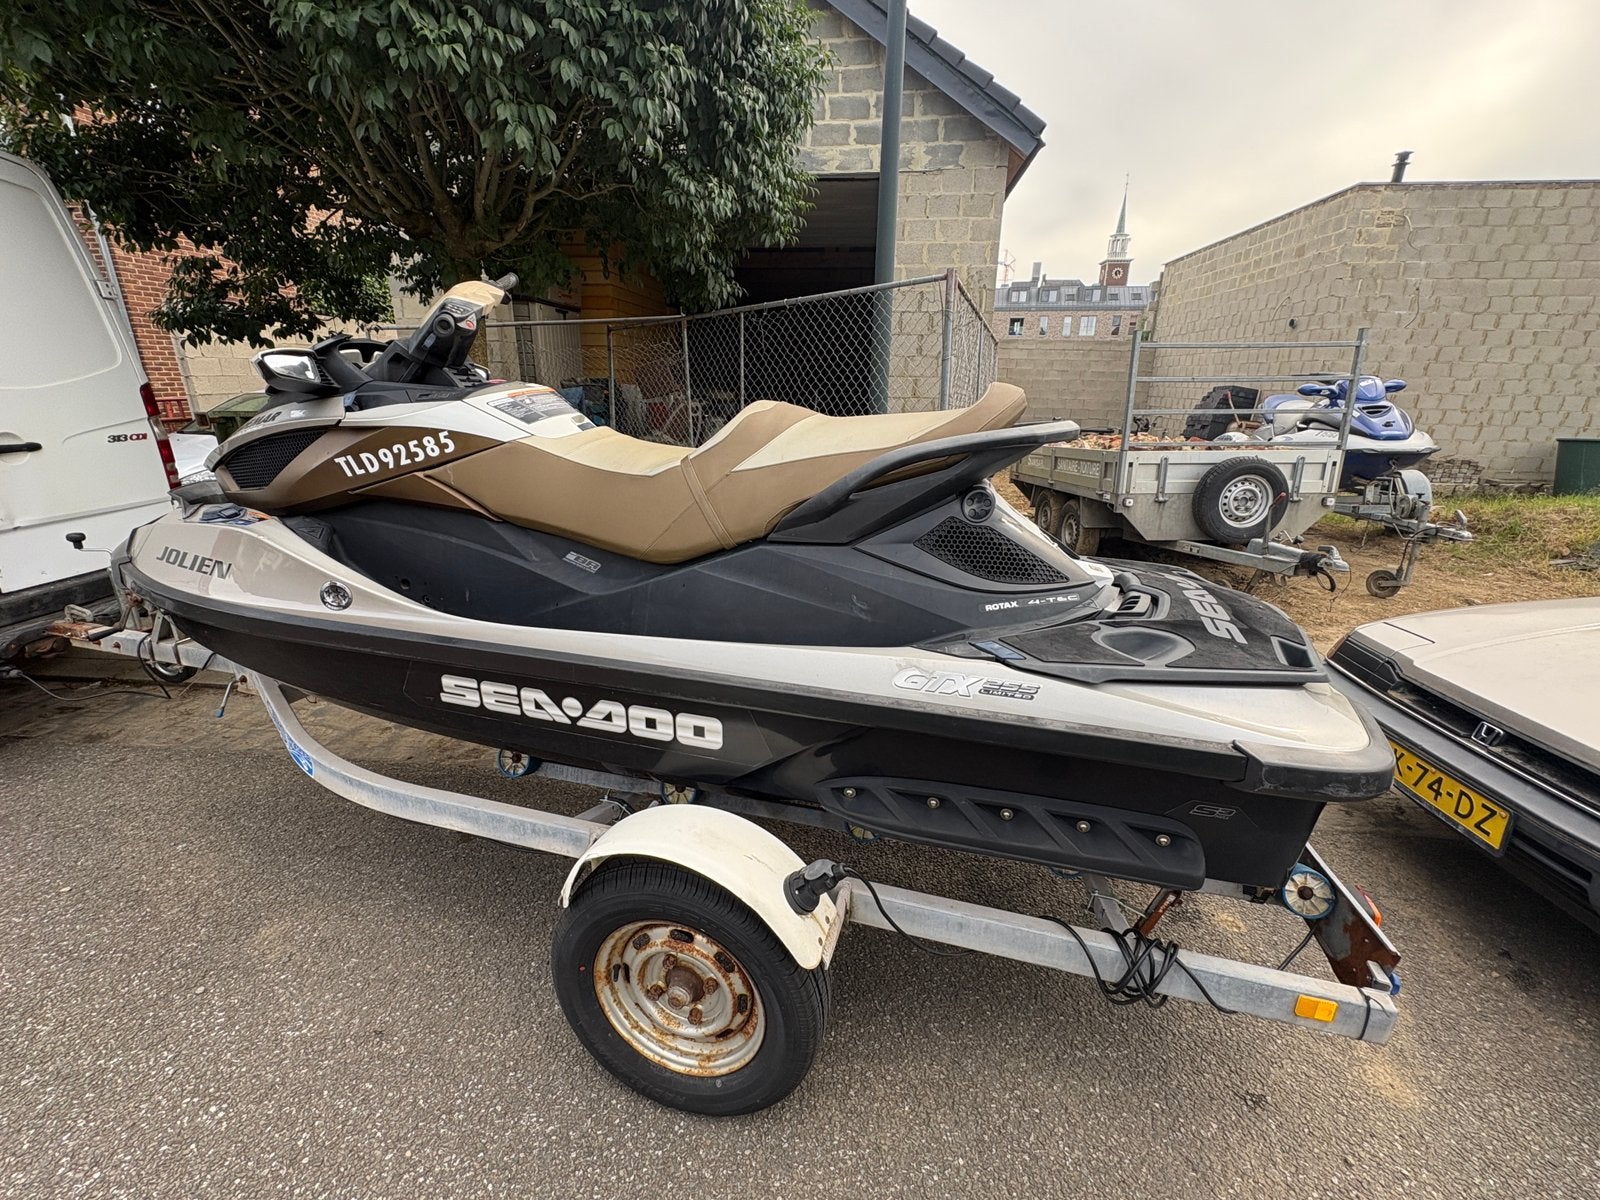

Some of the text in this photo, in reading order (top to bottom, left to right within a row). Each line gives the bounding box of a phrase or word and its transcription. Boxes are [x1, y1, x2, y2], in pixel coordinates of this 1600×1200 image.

[129, 432, 148, 441] CDI
[334, 430, 455, 477] TLD92585
[156, 546, 232, 580] JOLIEN
[985, 600, 1019, 612] ROTAX
[893, 667, 1041, 698] GTX 255
[980, 688, 1034, 701] LIMITED
